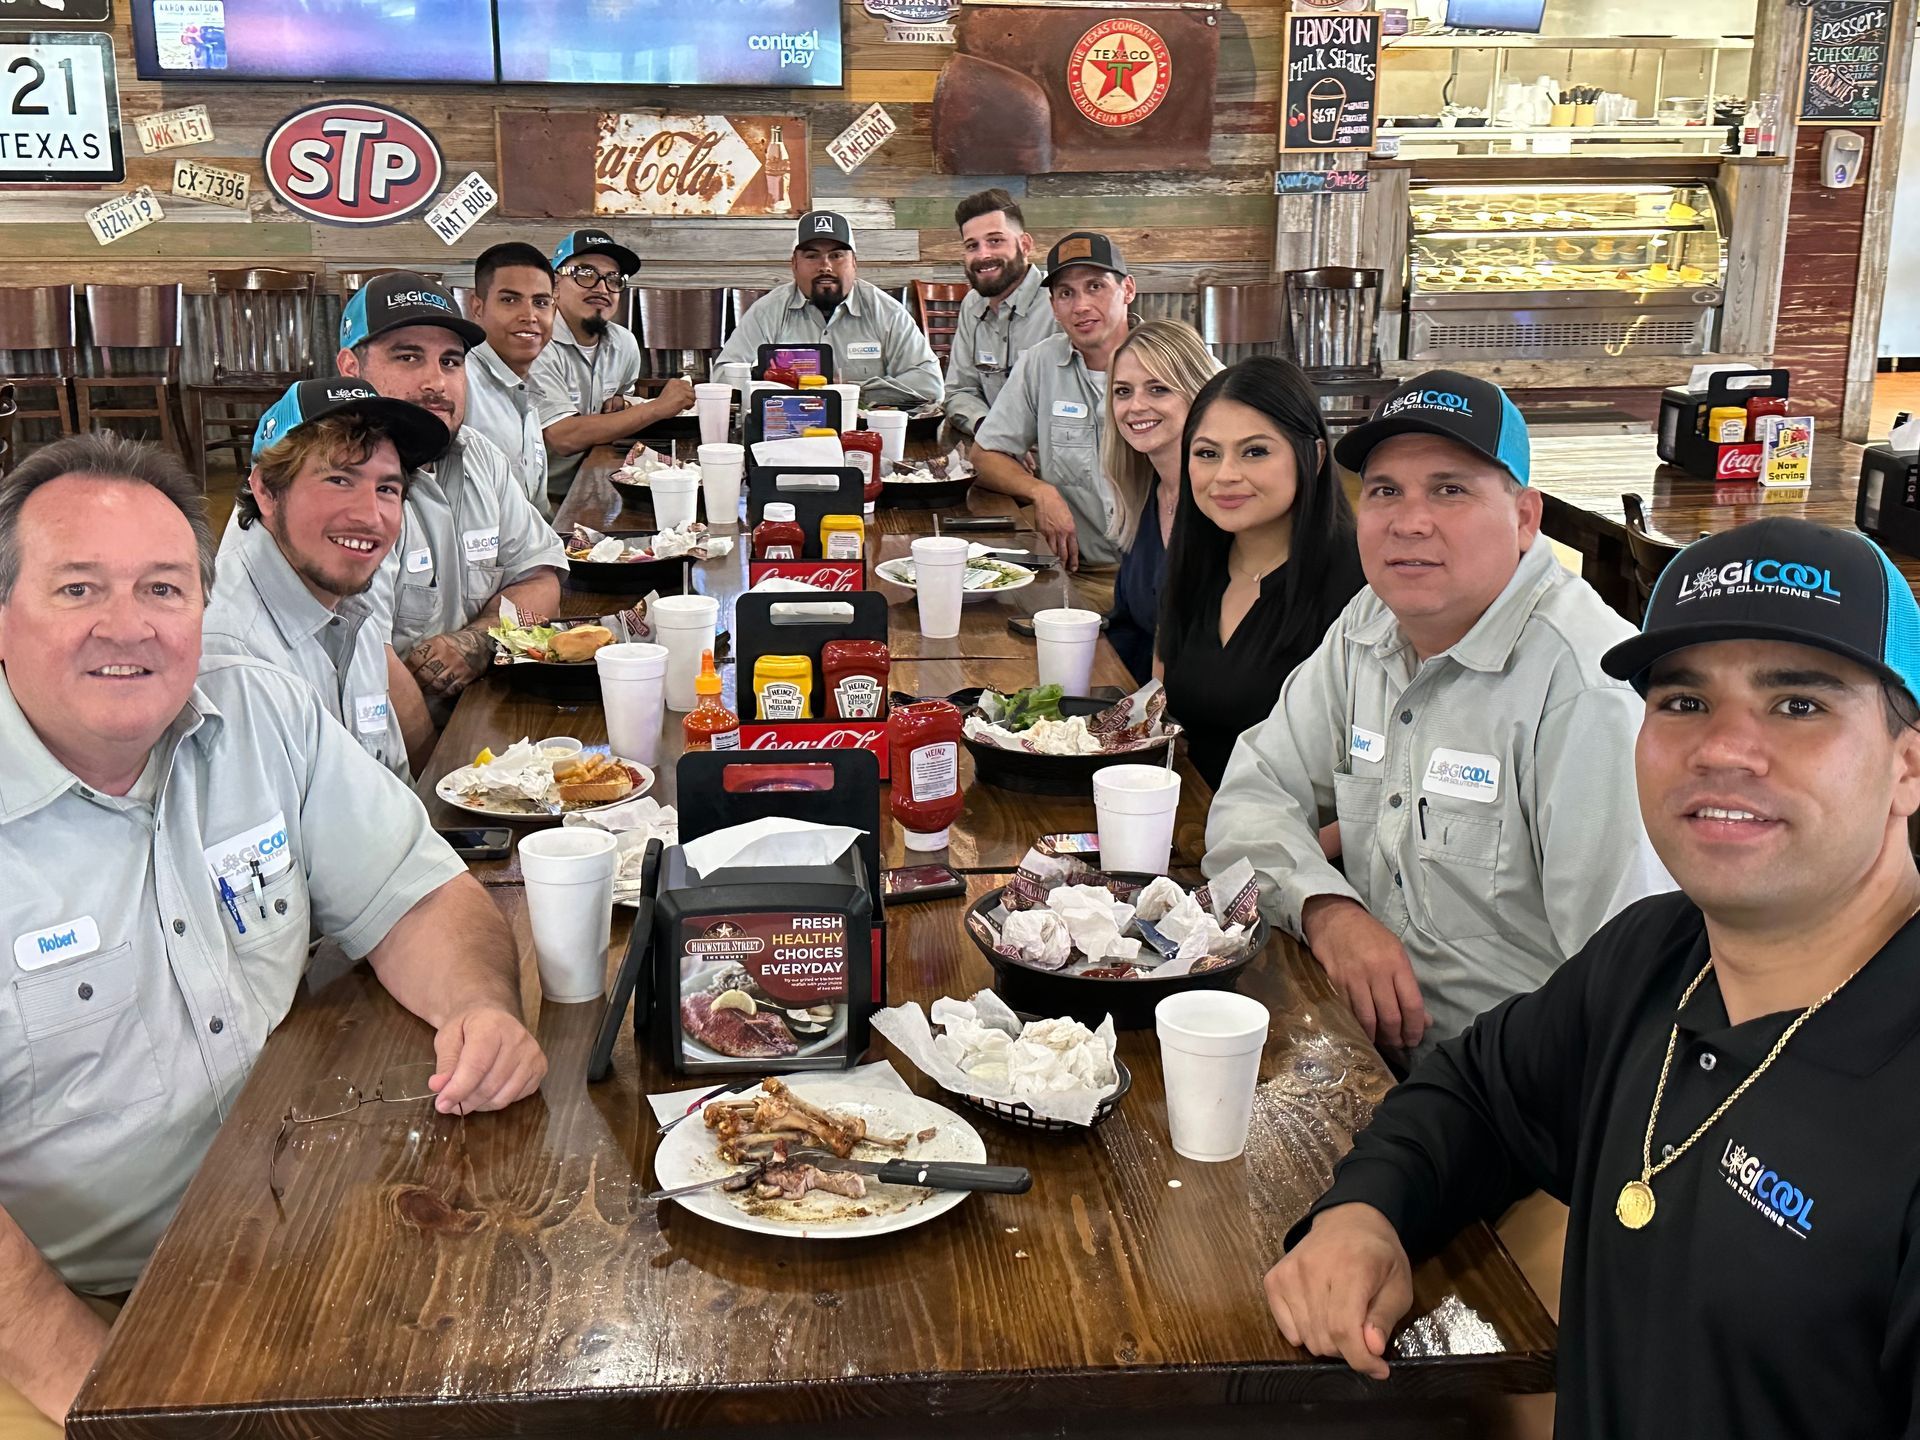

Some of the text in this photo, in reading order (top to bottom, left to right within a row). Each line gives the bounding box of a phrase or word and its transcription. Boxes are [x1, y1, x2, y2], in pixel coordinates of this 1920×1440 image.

[898, 32, 944, 42] VODKA
[1083, 25, 1110, 47] TEXAS
[1111, 21, 1154, 42] COMPANY
[780, 49, 814, 68] play
[1094, 49, 1149, 60] TEXACO
[1289, 48, 1327, 82] MILK
[8, 57, 77, 115] 21
[1072, 81, 1165, 123] PETROLEUM PRODUCTS
[0, 133, 100, 159] TEXAS
[287, 118, 420, 206] STP
[104, 196, 133, 213] TEXAS
[440, 187, 466, 209] TEXAS
[436, 185, 492, 239] NAT BUG
[1777, 462, 1798, 470] Now
[1768, 472, 1805, 481] Serving
[1699, 584, 1811, 599] AIR SOLUTIONS
[771, 688, 793, 696] HEINZ
[848, 682, 870, 691] HEINZ
[846, 693, 872, 701] TOMATO
[925, 748, 946, 758] HEINZ
[792, 916, 843, 930] FRESH
[37, 928, 78, 954] Robert
[772, 931, 844, 946] HEALTHY
[691, 940, 760, 953] BREWSTER STREET
[773, 946, 844, 960] CHOICES
[761, 961, 844, 976] EVERYDAY
[1726, 1176, 1786, 1228] AIR SOLUTIONS
